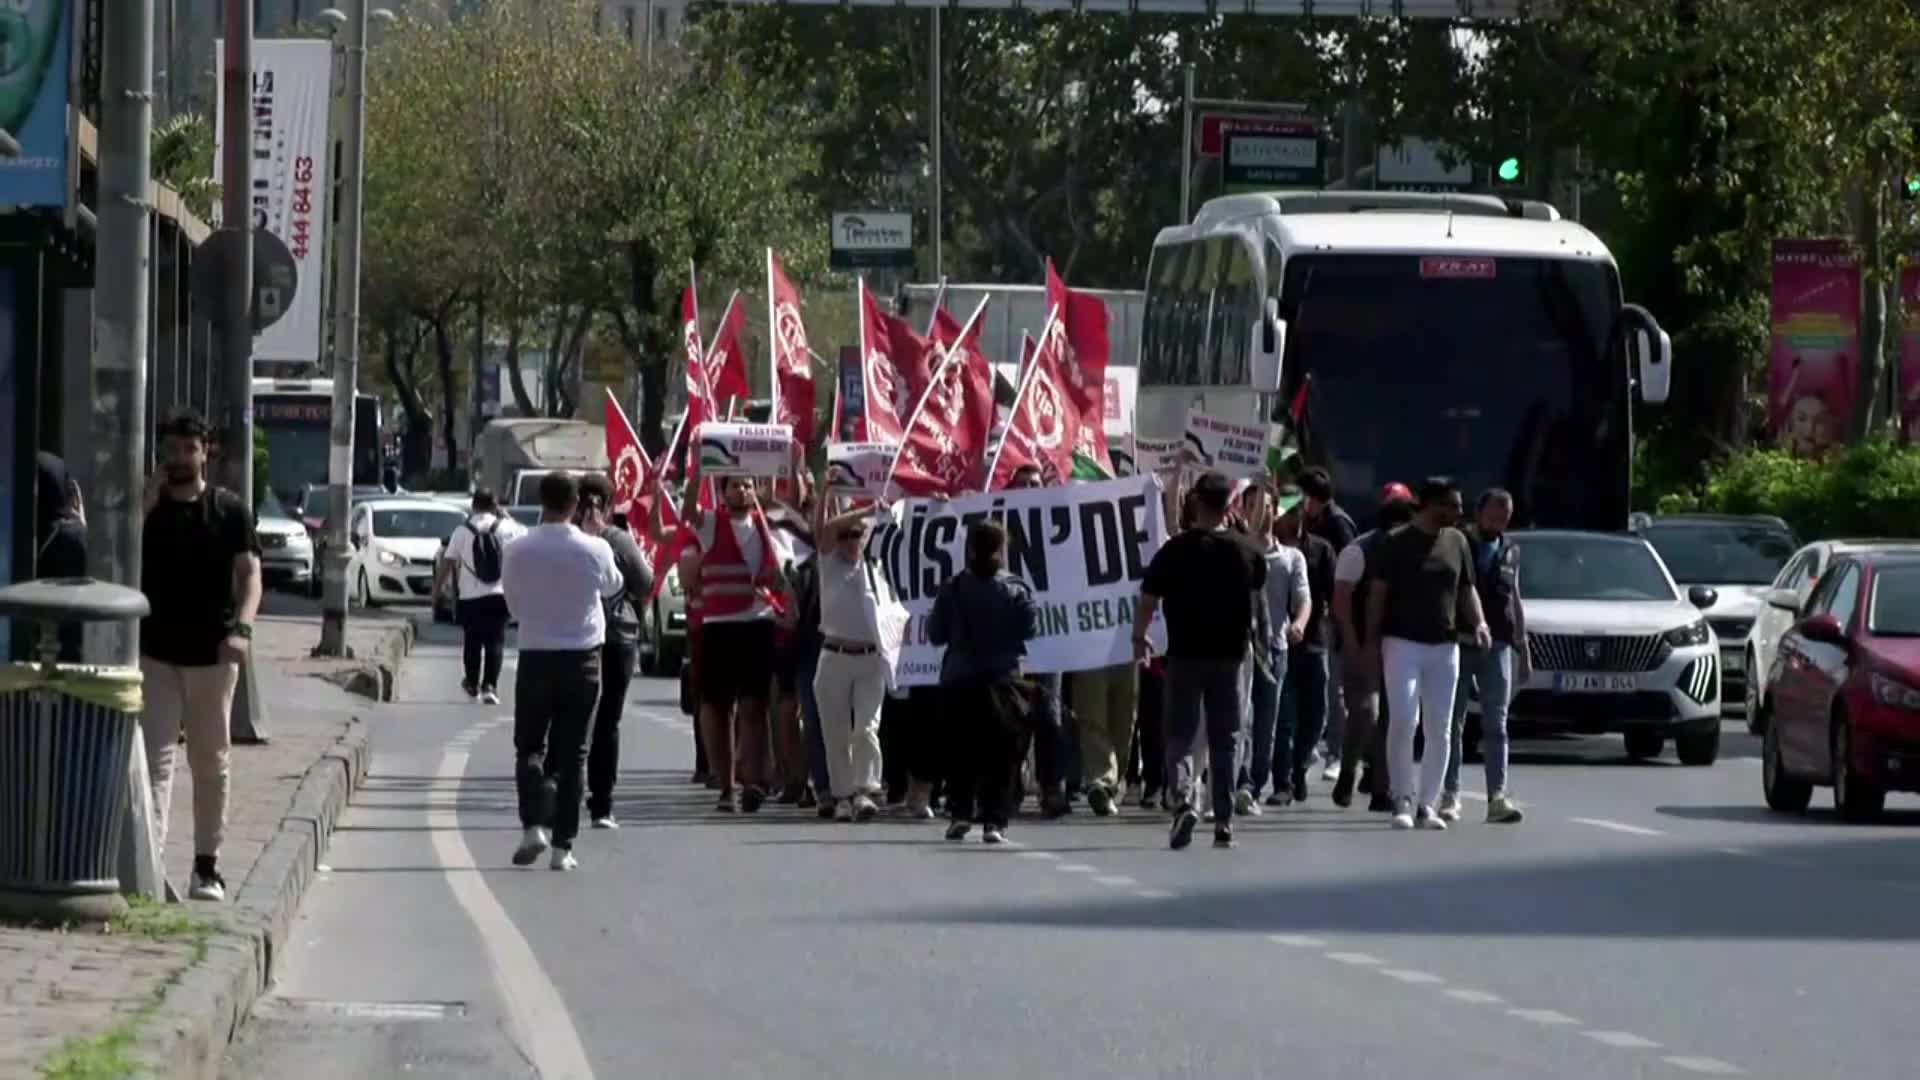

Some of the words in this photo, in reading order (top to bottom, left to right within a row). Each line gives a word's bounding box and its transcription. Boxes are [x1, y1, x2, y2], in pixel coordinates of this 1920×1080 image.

[295, 156, 313, 184] 63
[292, 187, 311, 214] 84
[291, 220, 310, 260] 444
